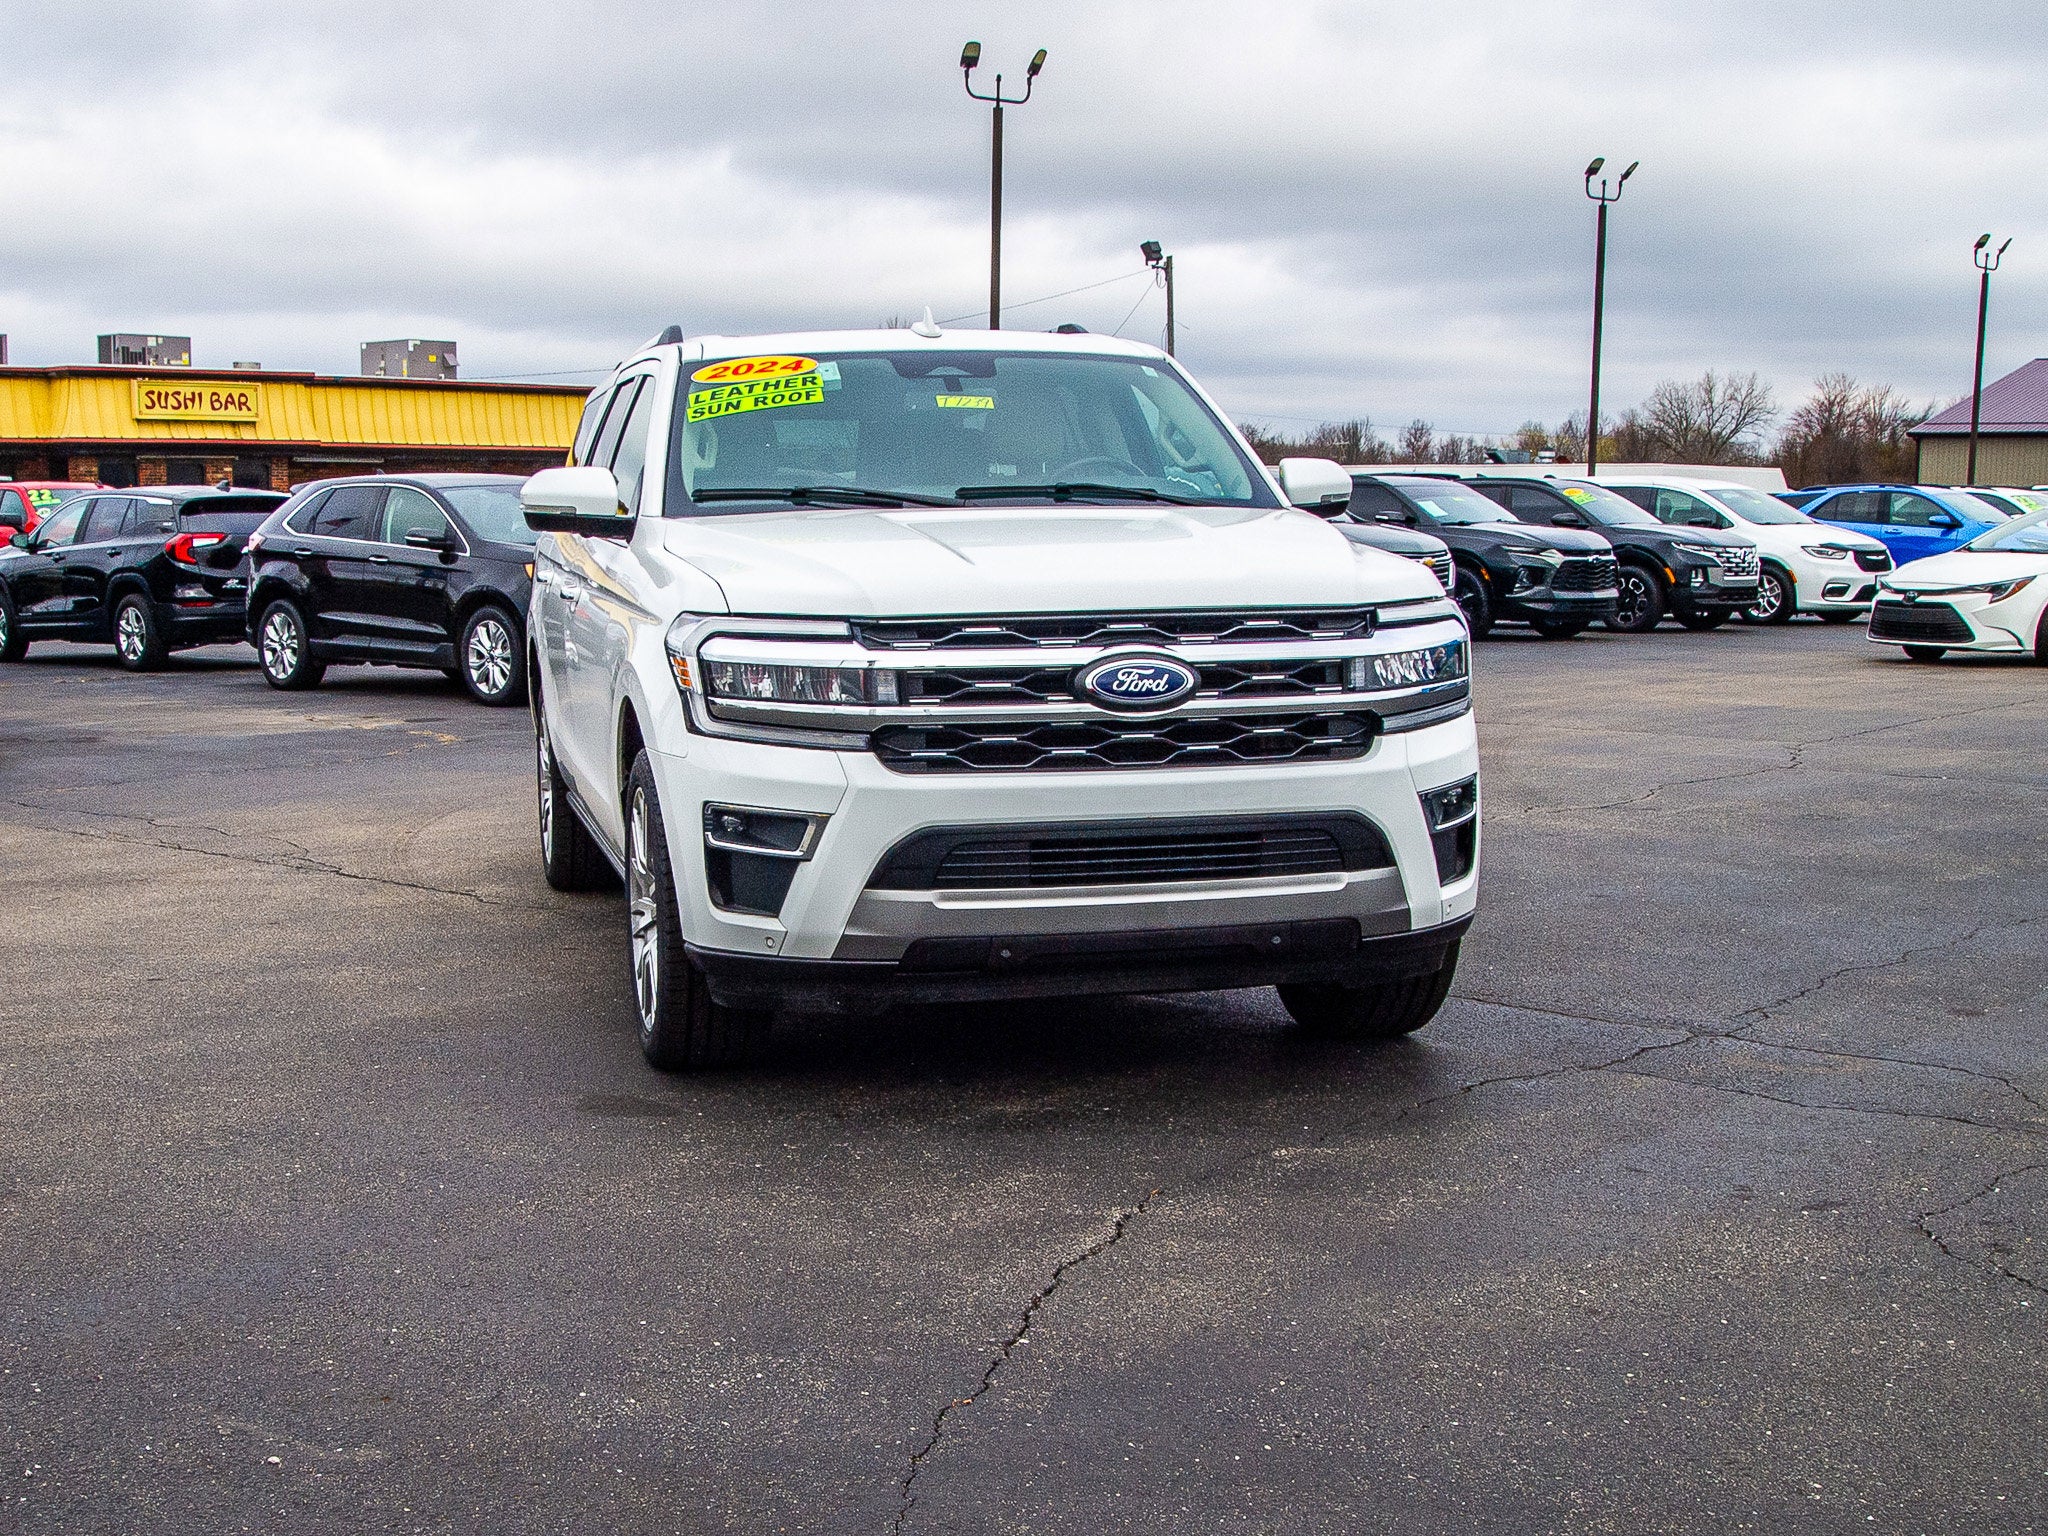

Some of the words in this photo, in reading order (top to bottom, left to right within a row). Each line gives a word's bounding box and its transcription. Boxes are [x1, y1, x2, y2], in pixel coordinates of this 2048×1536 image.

[706, 360, 805, 380] 2024
[145, 390, 202, 410] SUSHI
[210, 391, 252, 412] BAR
[693, 376, 818, 405] LEATHER
[691, 400, 741, 419] SUN
[753, 390, 817, 407] ROOF
[1112, 668, 1169, 692] Ford
